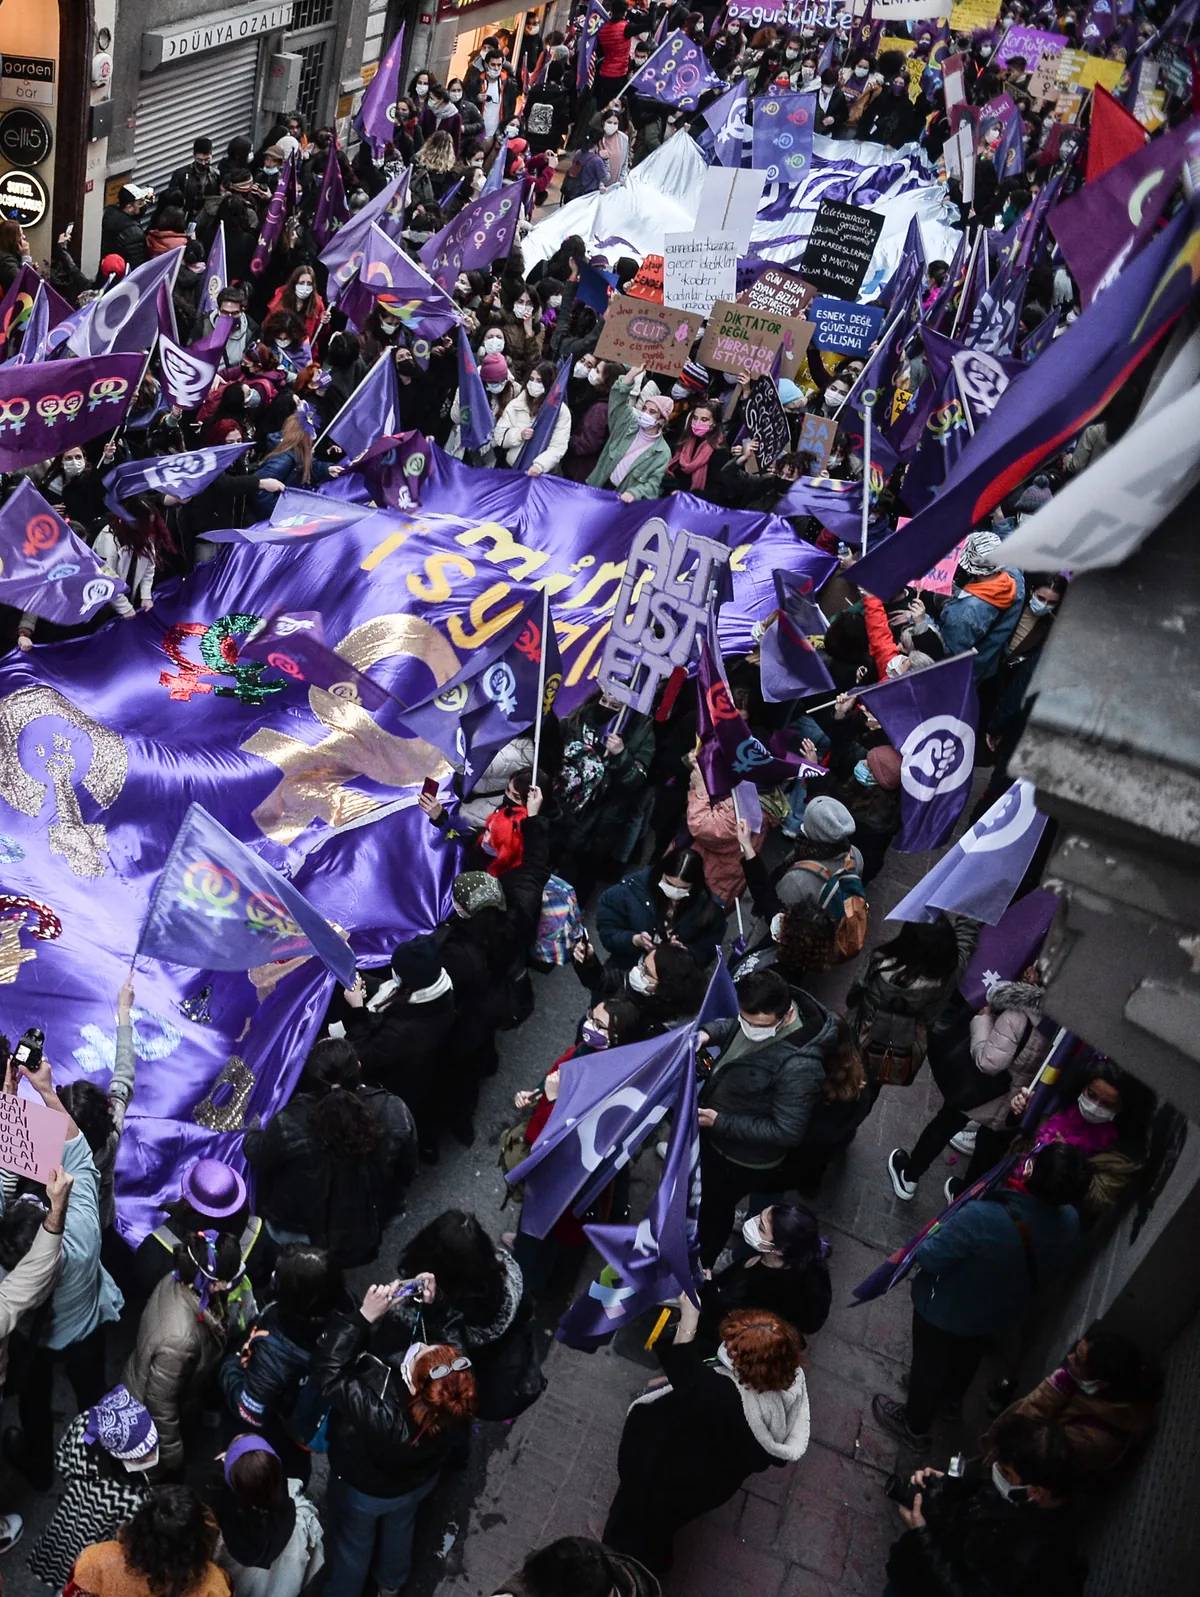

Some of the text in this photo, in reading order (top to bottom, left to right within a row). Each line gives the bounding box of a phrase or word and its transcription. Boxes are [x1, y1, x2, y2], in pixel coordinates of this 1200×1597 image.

[179, 25, 234, 55] DÜNYA
[16, 86, 38, 99] bar
[724, 309, 782, 335] DİKTATÖR
[816, 309, 873, 327] ESNEK DEĞİL
[632, 321, 665, 339] CLIT
[719, 325, 749, 340] DEĞİL
[819, 321, 869, 337] GÜVENCELİ
[818, 332, 862, 349] ÇALIŞMA
